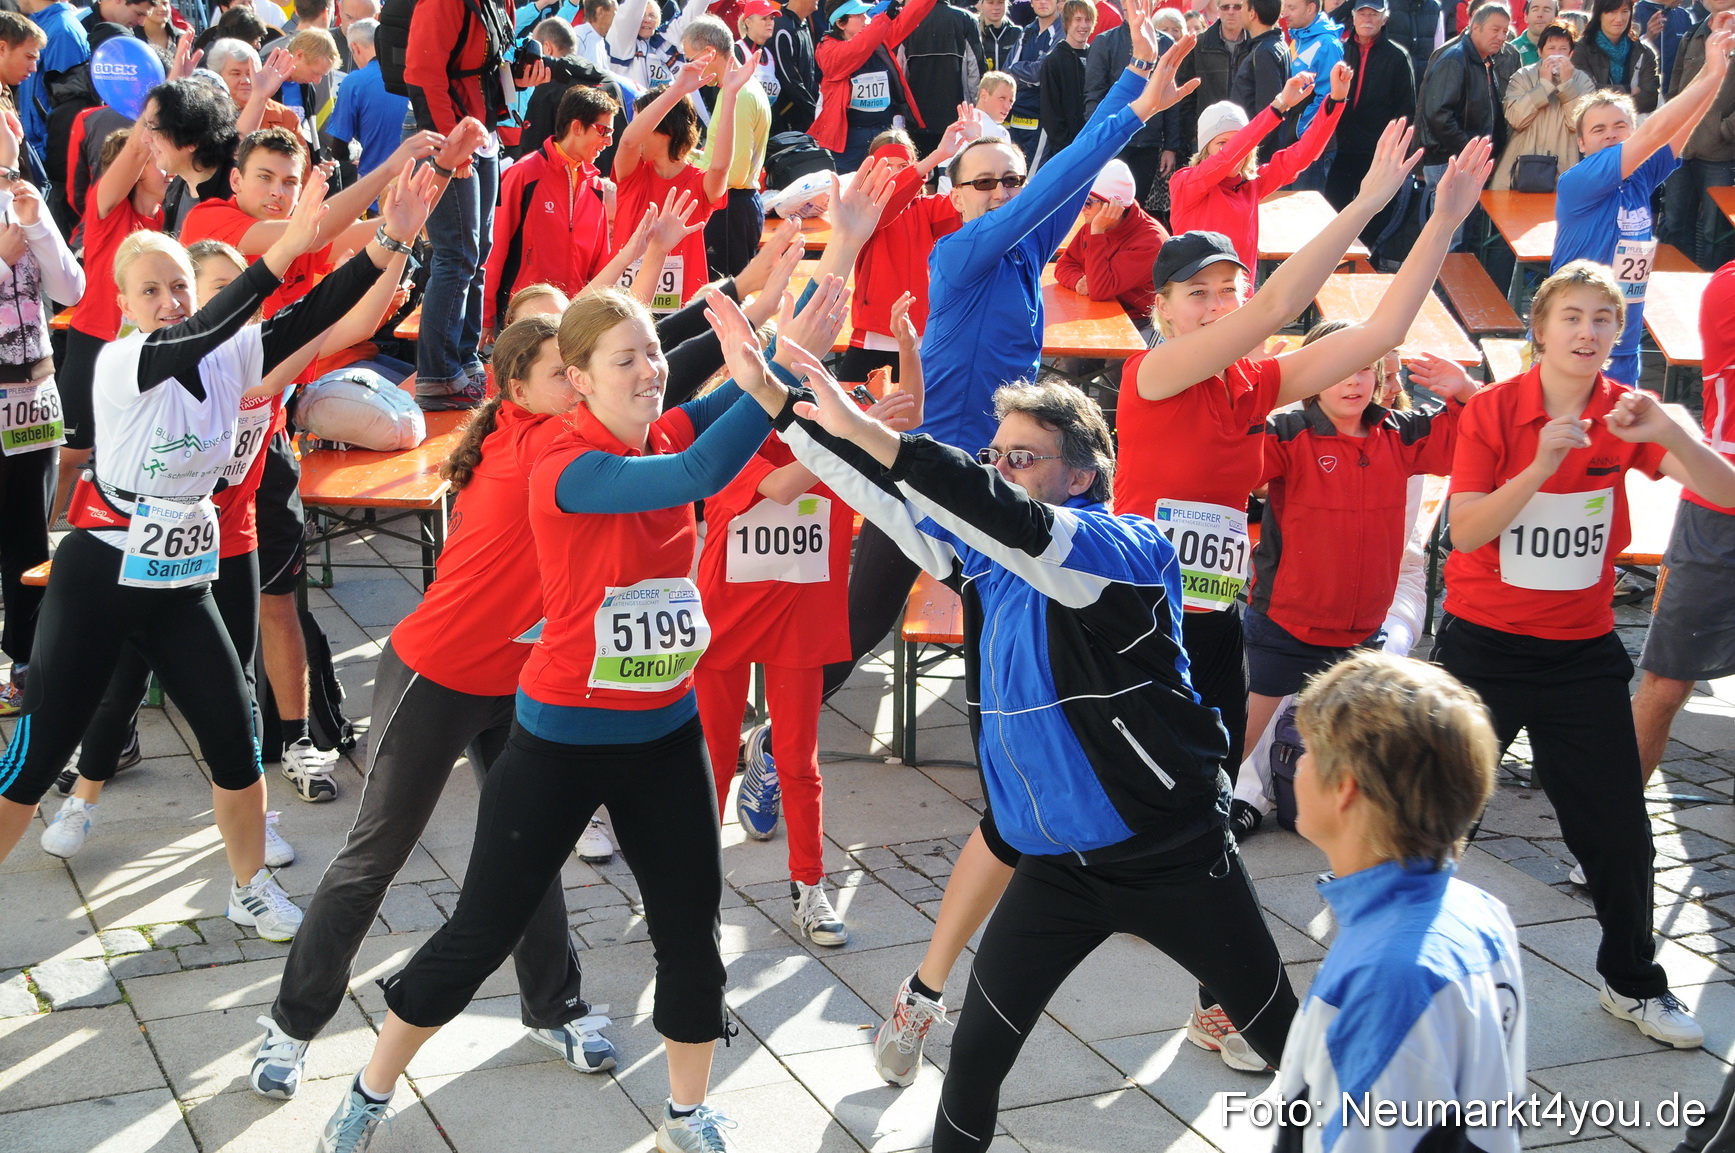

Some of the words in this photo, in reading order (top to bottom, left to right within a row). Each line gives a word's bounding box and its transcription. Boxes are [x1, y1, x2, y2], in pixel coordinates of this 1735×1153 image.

[94, 63, 138, 75] BOCK
[857, 82, 884, 99] 2107
[860, 99, 883, 107] Marion
[2, 395, 59, 427] 10668
[11, 424, 55, 444] Isabella
[151, 506, 196, 519] PFLEIDERER
[1172, 508, 1221, 524] PFLEIDERER
[140, 521, 214, 558] 2639
[736, 523, 823, 555] 10096
[1510, 523, 1605, 559] 10095
[1163, 527, 1246, 575] 10651
[147, 559, 203, 577] Sandra
[668, 590, 695, 600] BOCK
[612, 609, 697, 653] 5199
